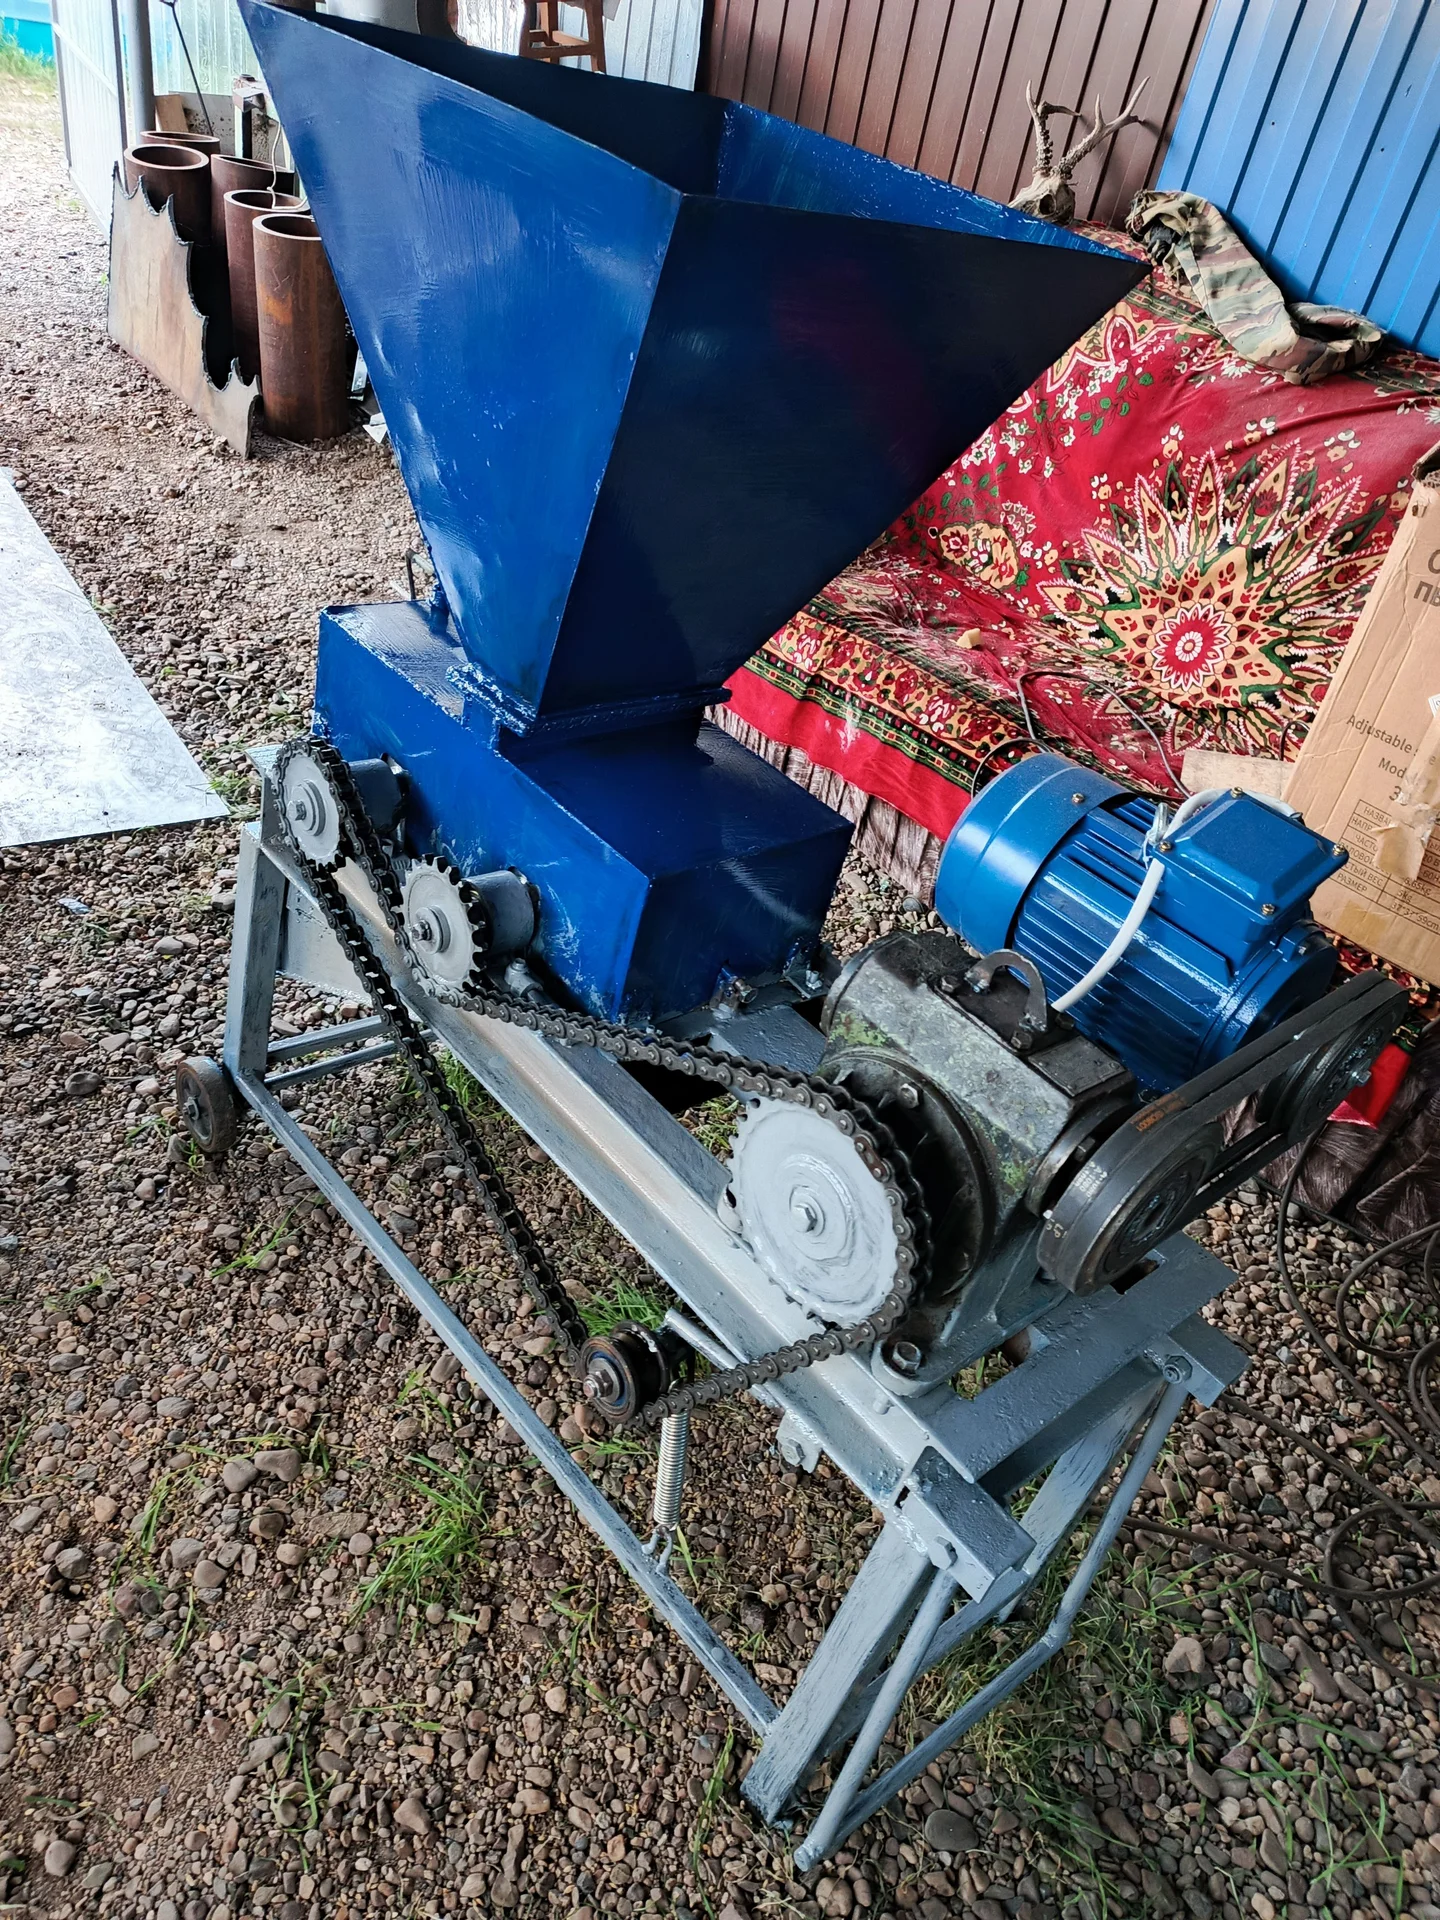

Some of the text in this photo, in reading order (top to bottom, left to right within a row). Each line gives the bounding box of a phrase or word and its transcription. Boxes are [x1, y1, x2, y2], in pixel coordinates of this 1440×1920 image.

[1346, 714, 1413, 754] Adjustable
[1378, 757, 1408, 779] Mod
[1337, 873, 1368, 892] РАЗМЕР
[1367, 873, 1384, 887] ВЕС
[1397, 889, 1413, 902] 5kg
